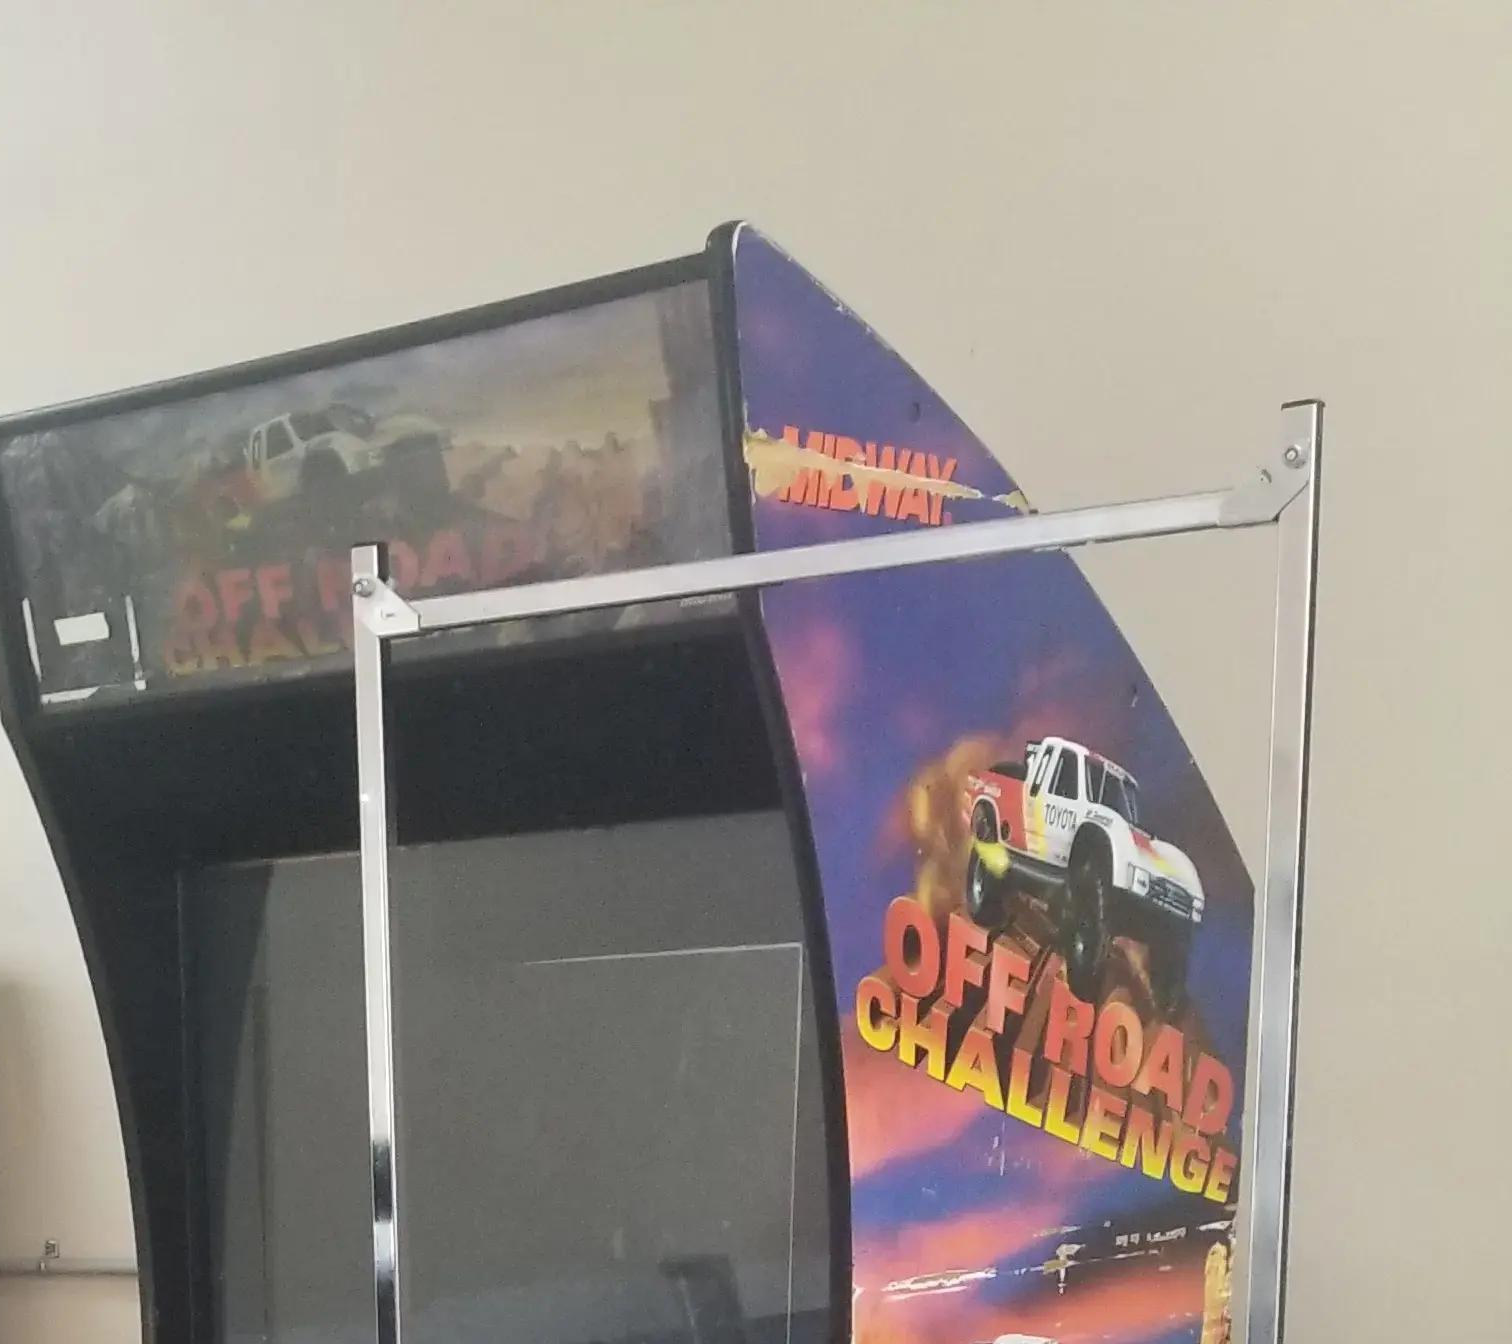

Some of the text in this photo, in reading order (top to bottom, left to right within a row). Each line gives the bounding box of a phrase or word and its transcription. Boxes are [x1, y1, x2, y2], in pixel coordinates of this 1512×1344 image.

[779, 425, 957, 526] MIDWAY
[173, 563, 293, 628] OFF
[1045, 803, 1078, 831] TOYOTA
[884, 897, 1234, 1134] OFF ROAD
[856, 976, 1238, 1203] CHALLENGE
